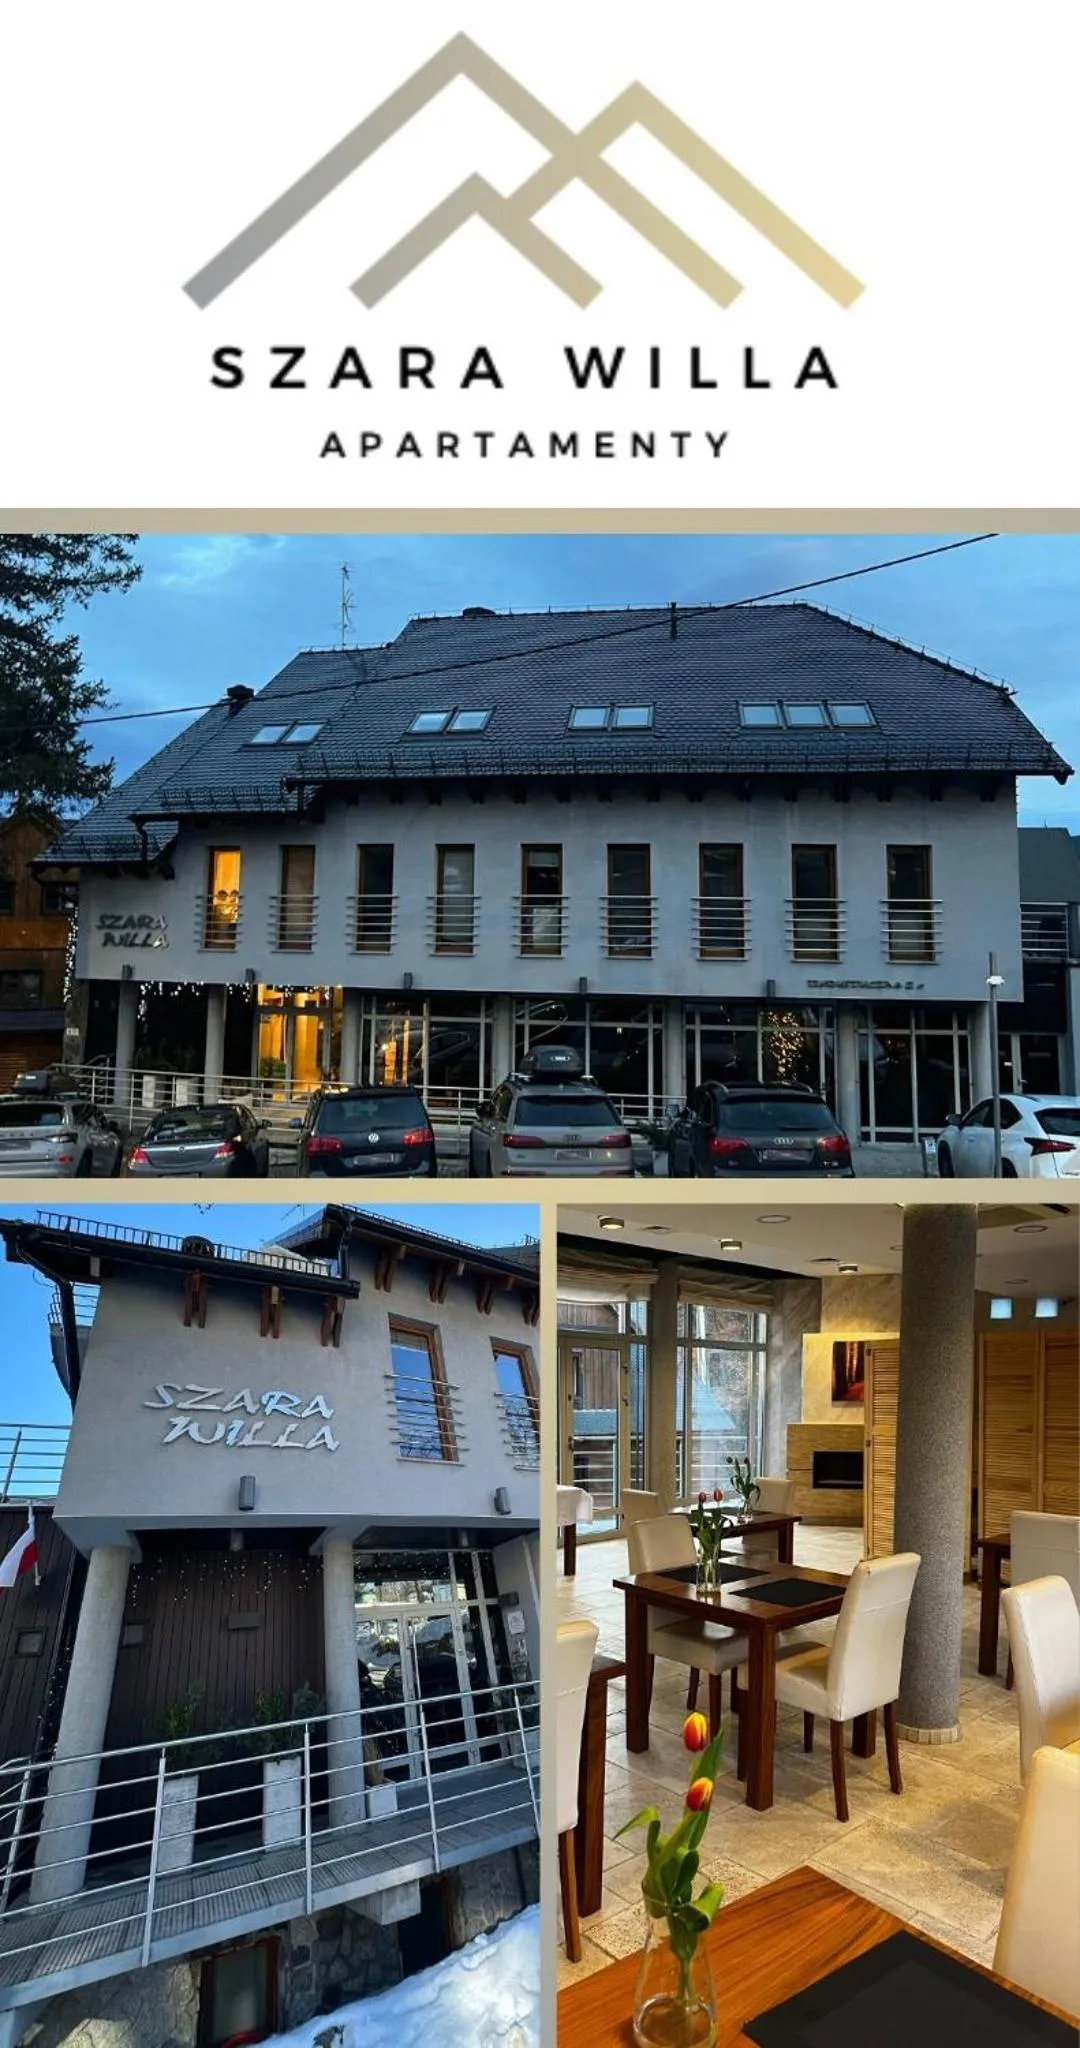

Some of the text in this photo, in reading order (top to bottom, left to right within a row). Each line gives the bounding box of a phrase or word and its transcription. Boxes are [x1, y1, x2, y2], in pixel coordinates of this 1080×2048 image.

[96, 914, 169, 931] SZARA
[102, 932, 170, 949] WILLA
[143, 1382, 336, 1420] SZARA
[163, 1415, 341, 1451] WILLA
